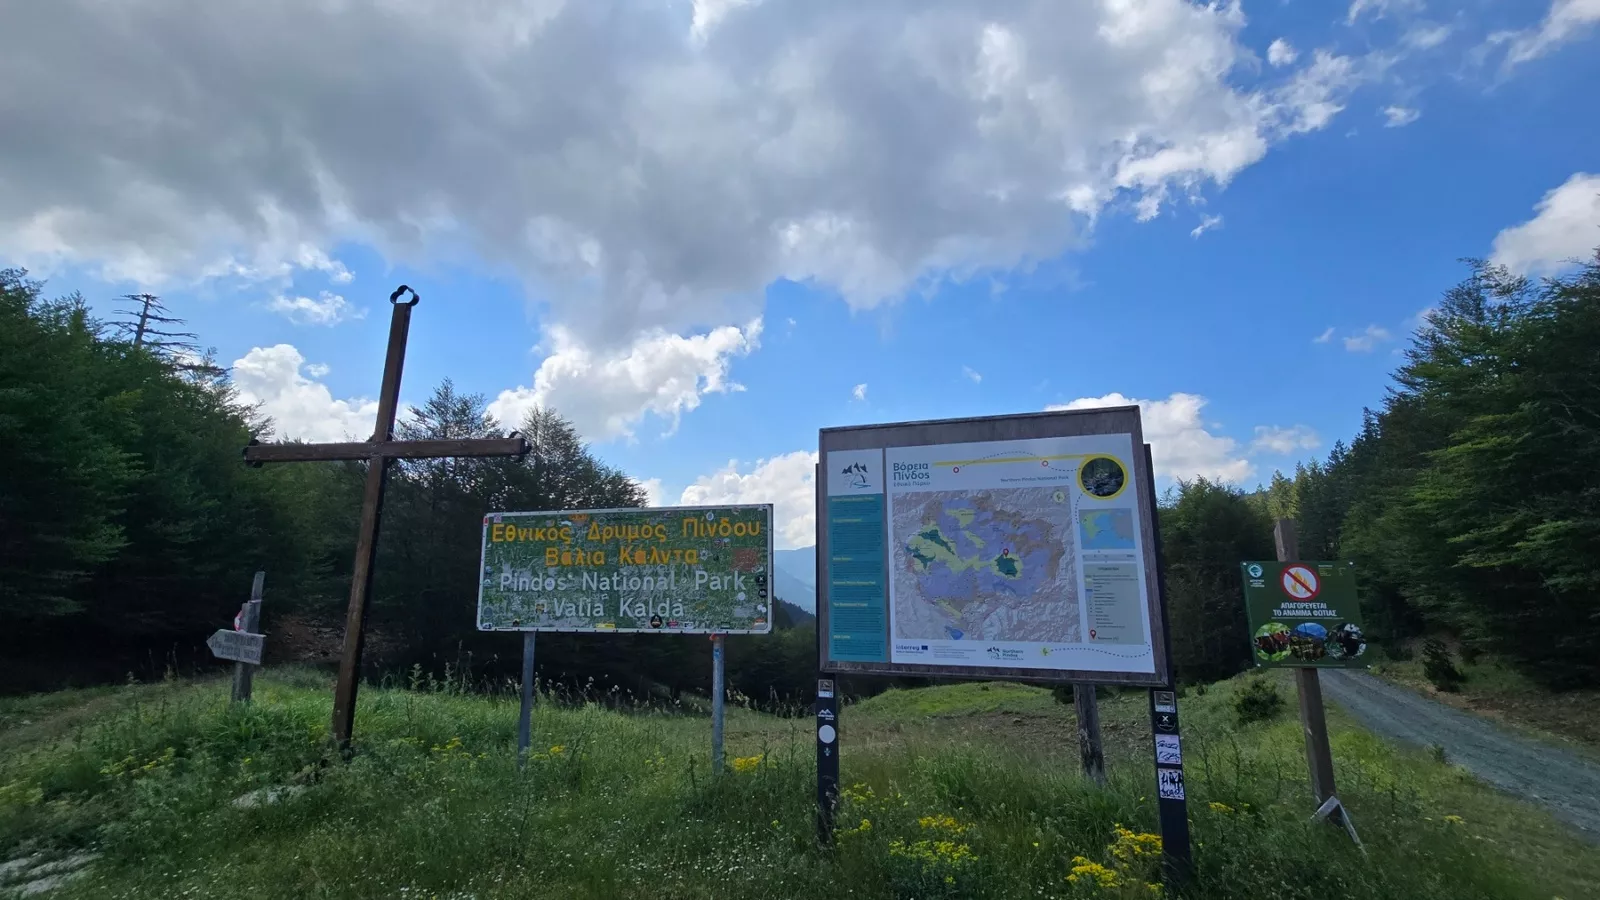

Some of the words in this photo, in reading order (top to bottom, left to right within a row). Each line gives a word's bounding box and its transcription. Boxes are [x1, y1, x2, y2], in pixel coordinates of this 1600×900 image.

[893, 461, 929, 472] Βόρεια
[893, 471, 930, 480] Πίνδος
[492, 521, 571, 544] Εθνικός
[587, 520, 667, 543] Δρυμός
[682, 516, 760, 537] Πίνδου
[545, 545, 605, 567] Βάλια
[619, 544, 699, 566] Κάλντα
[500, 571, 567, 591] Pindos
[582, 571, 677, 591] National
[695, 570, 747, 590] Park
[553, 598, 604, 617] Valia
[620, 597, 685, 617] Kalda
[1273, 609, 1282, 617] ΤΟ
[1282, 609, 1312, 617] ΑΝΑΜΜΑ
[1312, 609, 1337, 617] ΦΩΤΙΑΣ
